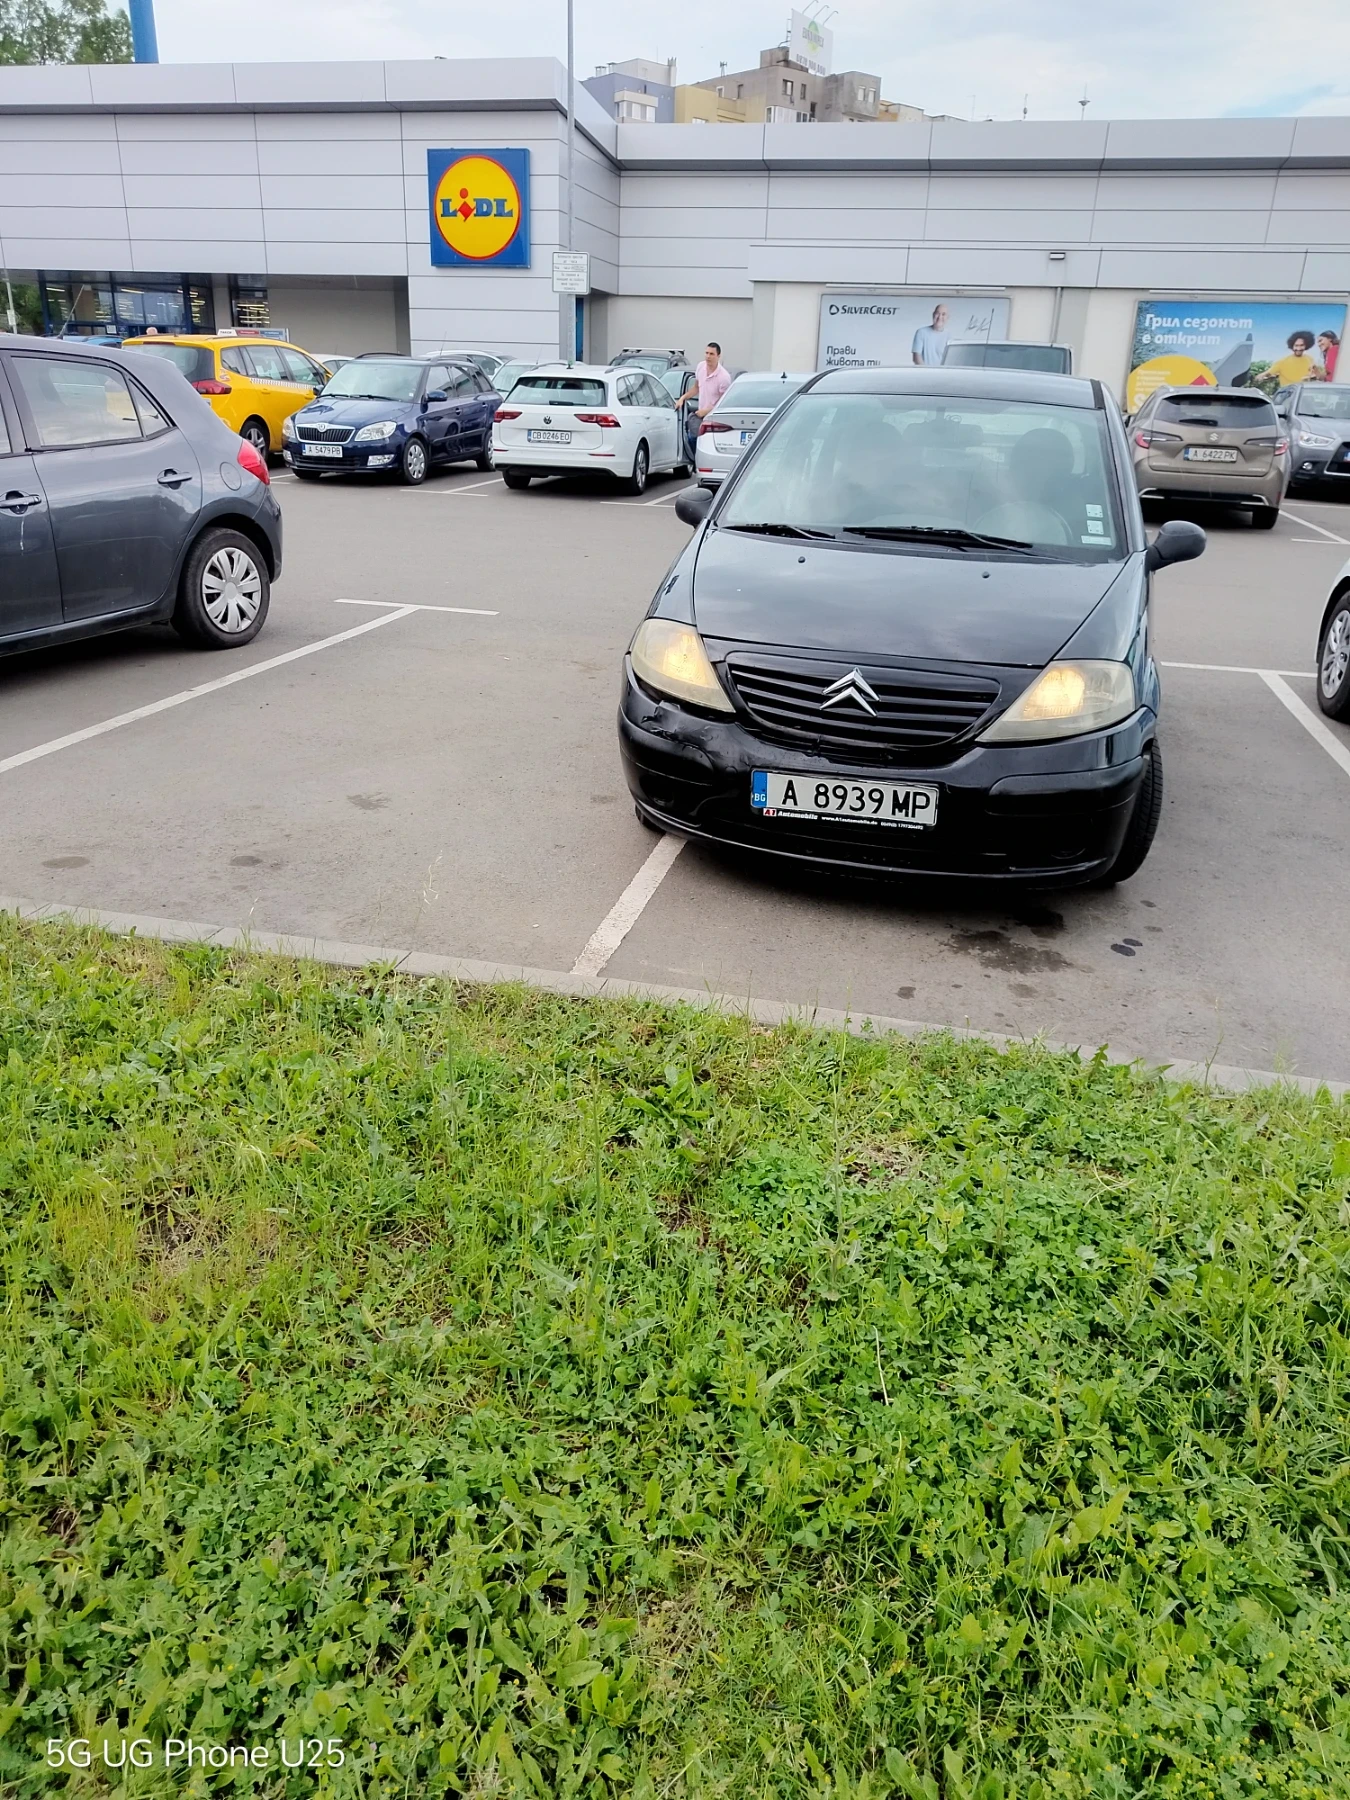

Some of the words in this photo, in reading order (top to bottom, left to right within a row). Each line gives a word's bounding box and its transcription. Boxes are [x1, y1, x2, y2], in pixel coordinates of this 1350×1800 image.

[1144, 314, 1181, 330] Грил
[1183, 315, 1253, 330] сезонът
[1142, 334, 1151, 345] е
[1154, 332, 1221, 347] открит
[826, 345, 857, 357] Прави
[825, 356, 865, 367] живота
[754, 793, 766, 802] BG
[781, 779, 798, 806] A
[813, 783, 885, 814] 8939
[891, 789, 931, 818] MP
